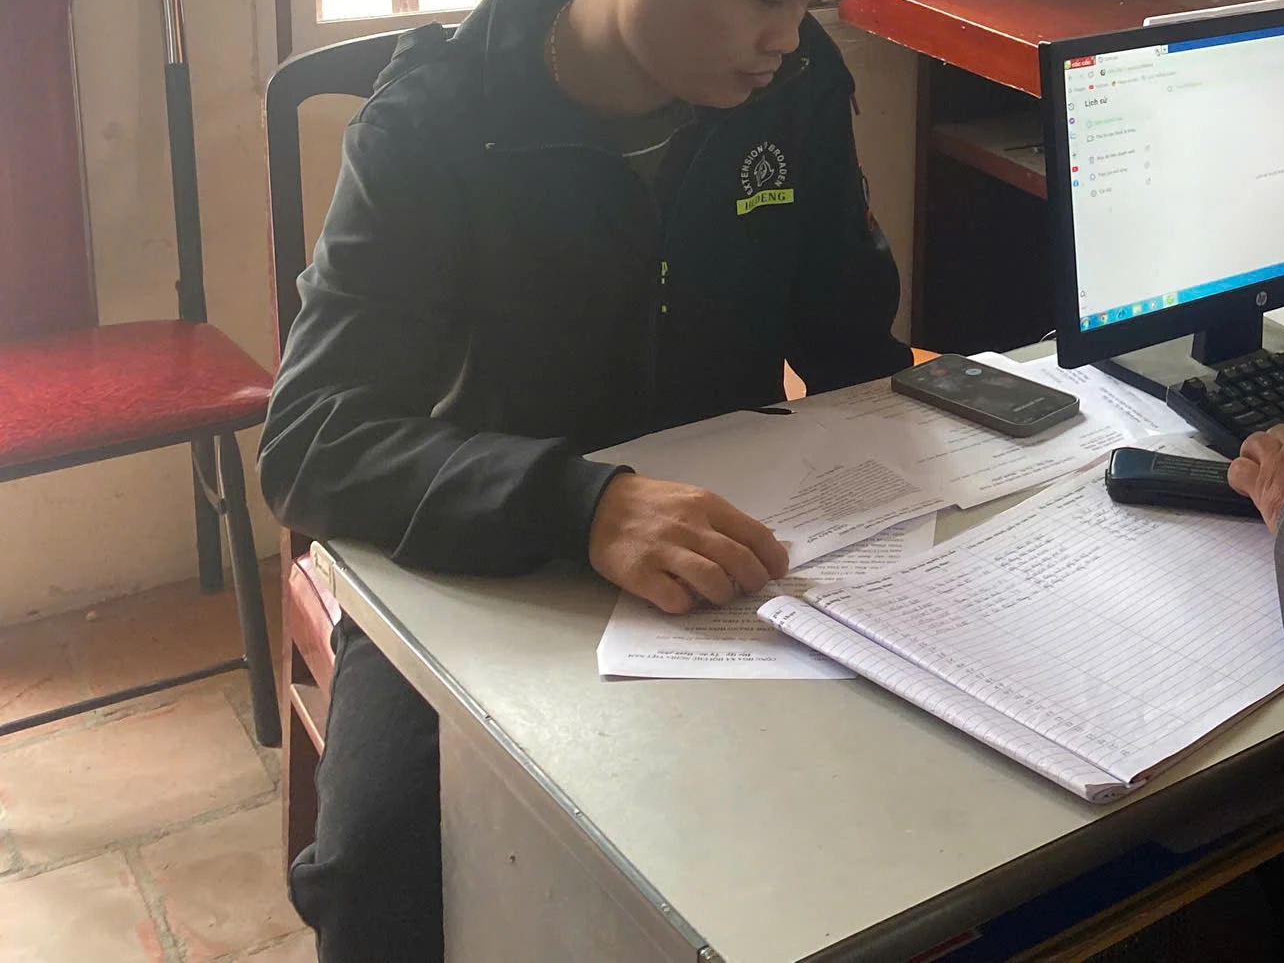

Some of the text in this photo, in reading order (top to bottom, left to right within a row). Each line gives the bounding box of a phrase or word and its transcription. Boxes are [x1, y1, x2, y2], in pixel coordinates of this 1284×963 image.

[1085, 97, 1098, 107] Lịch
[741, 144, 787, 196] EXTENSION BROADEN
